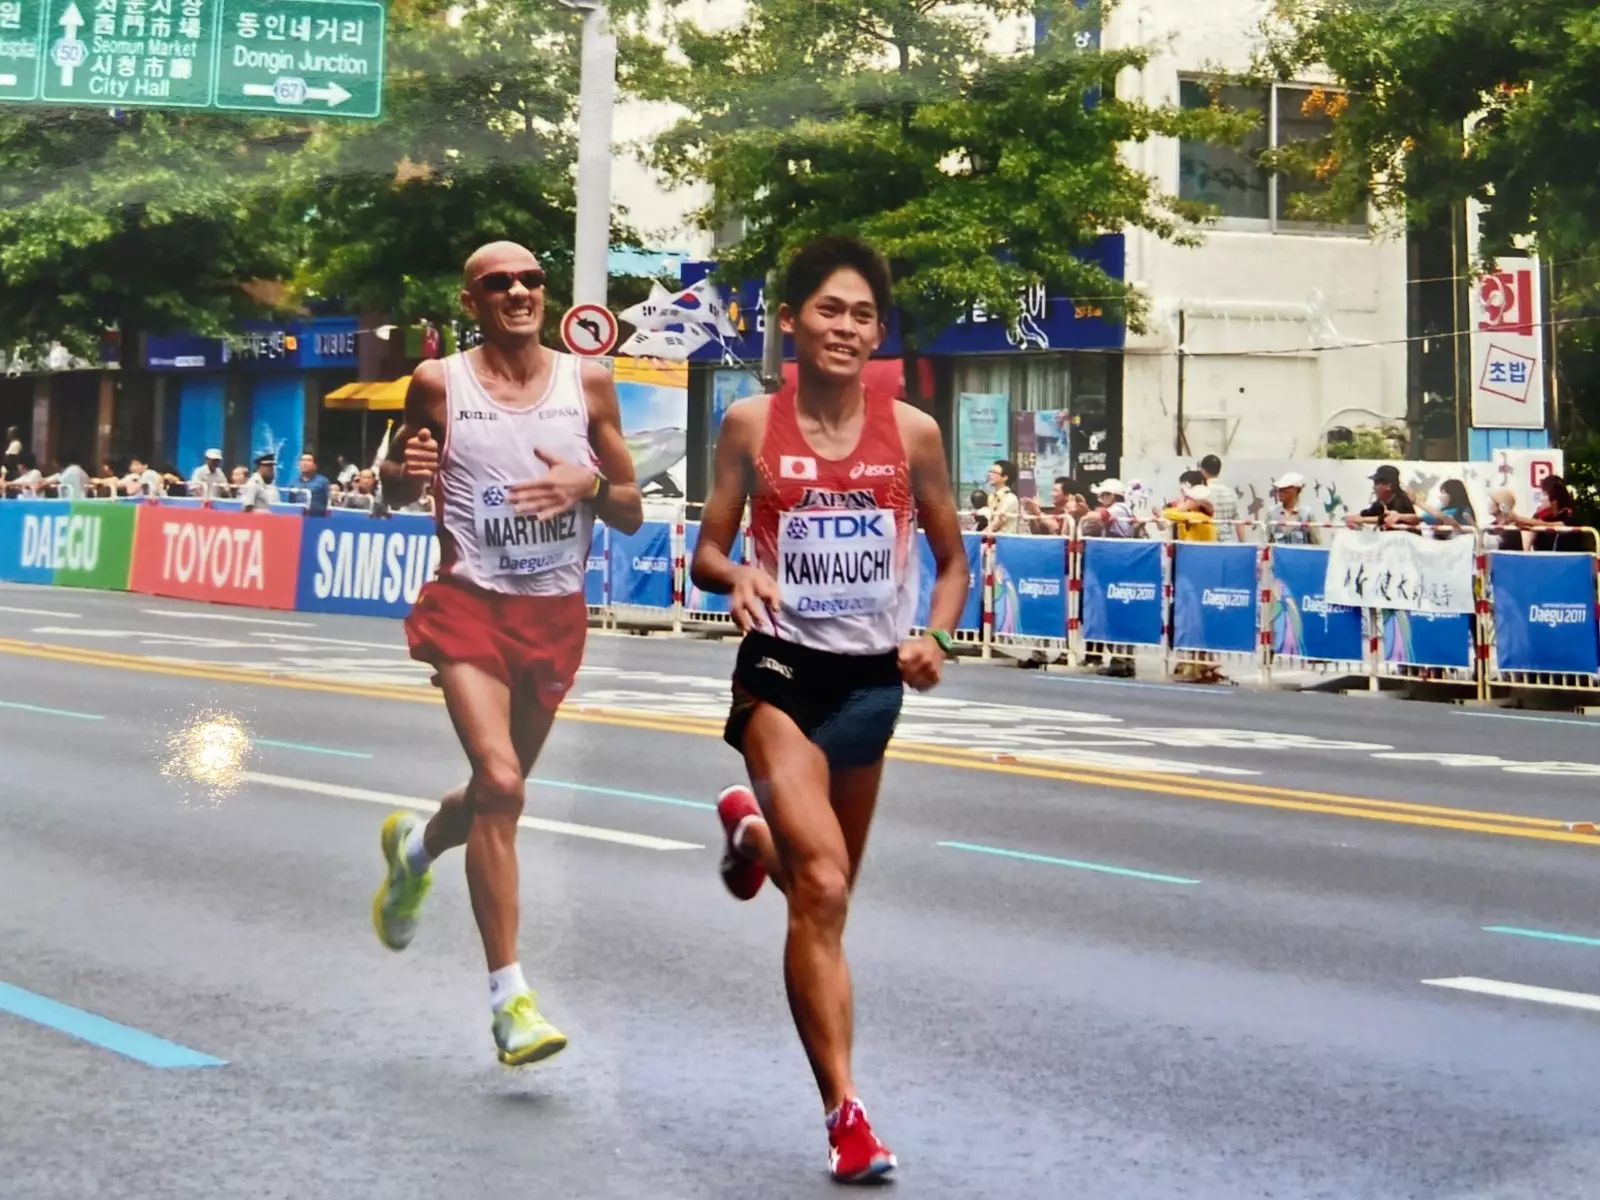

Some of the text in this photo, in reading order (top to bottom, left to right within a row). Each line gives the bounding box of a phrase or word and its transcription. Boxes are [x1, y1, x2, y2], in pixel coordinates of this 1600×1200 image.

[93, 14, 201, 39] 西門市場
[236, 12, 364, 46] 동인네거리
[60, 46, 77, 61] 50
[92, 36, 197, 58] Seomun Market
[233, 45, 368, 75] Dongin Junction
[89, 76, 171, 98] City Hall
[280, 83, 298, 98] 67
[1489, 360, 1527, 384] 초밥
[795, 487, 878, 511] JAPAN
[484, 510, 577, 548] MARTINEZ
[809, 515, 884, 538] TDK
[20, 514, 102, 571] DAEGU
[163, 522, 265, 590] TOYOTA
[785, 549, 890, 585] KAWAUCHI
